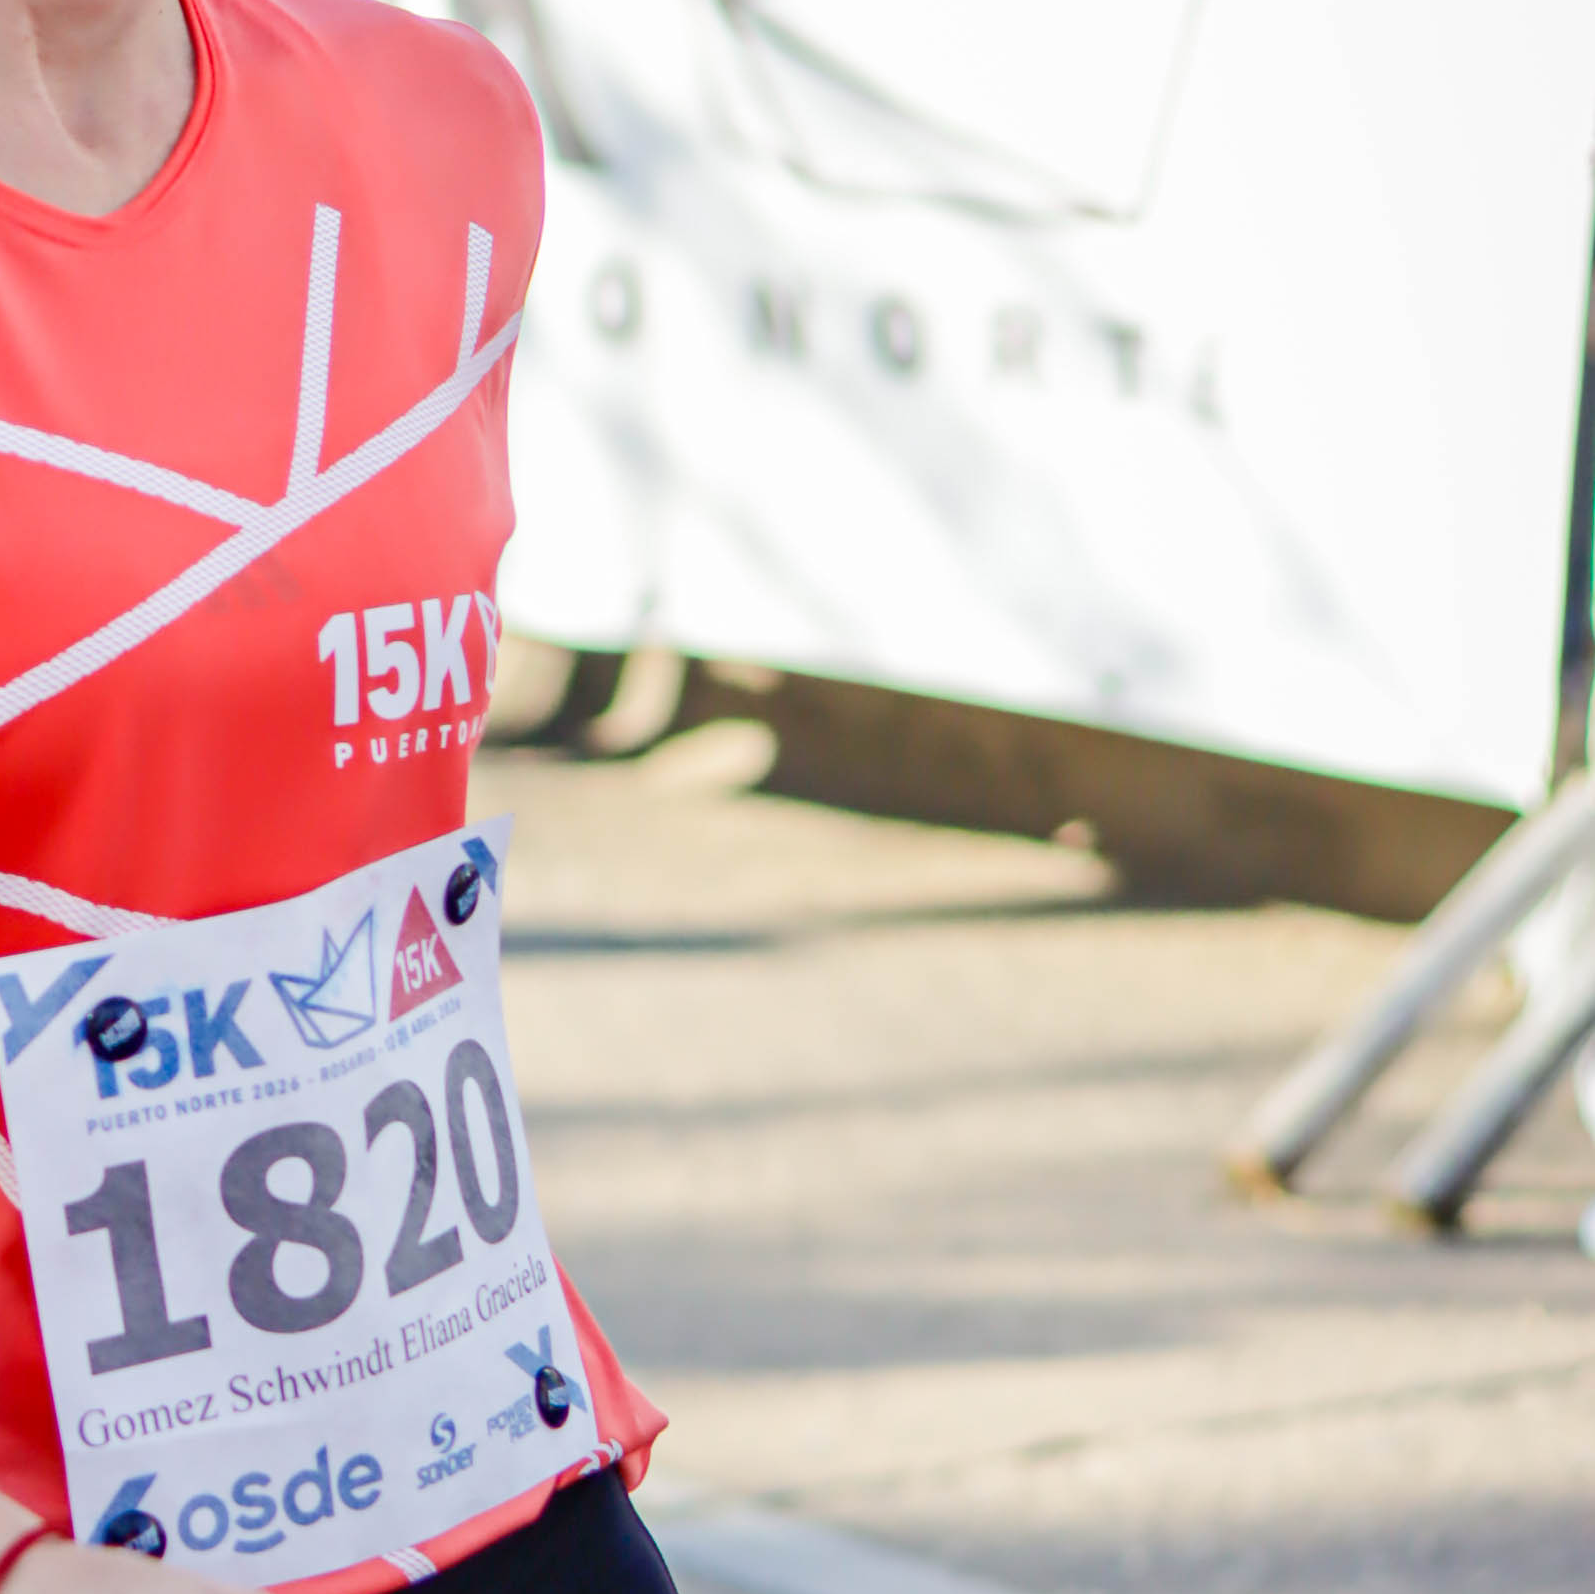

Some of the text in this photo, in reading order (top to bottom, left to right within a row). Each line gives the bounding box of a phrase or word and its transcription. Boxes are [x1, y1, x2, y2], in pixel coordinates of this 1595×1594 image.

[318, 593, 473, 727] 15K
[395, 932, 443, 995] 15K
[85, 1104, 168, 1136] PUERTO
[174, 1087, 244, 1115] NORTE
[252, 1076, 301, 1101] 2026
[63, 1038, 520, 1376] 1820
[77, 1253, 548, 1448] Gomez Schwindt Eliana Graciela
[177, 1442, 383, 1553] osde
